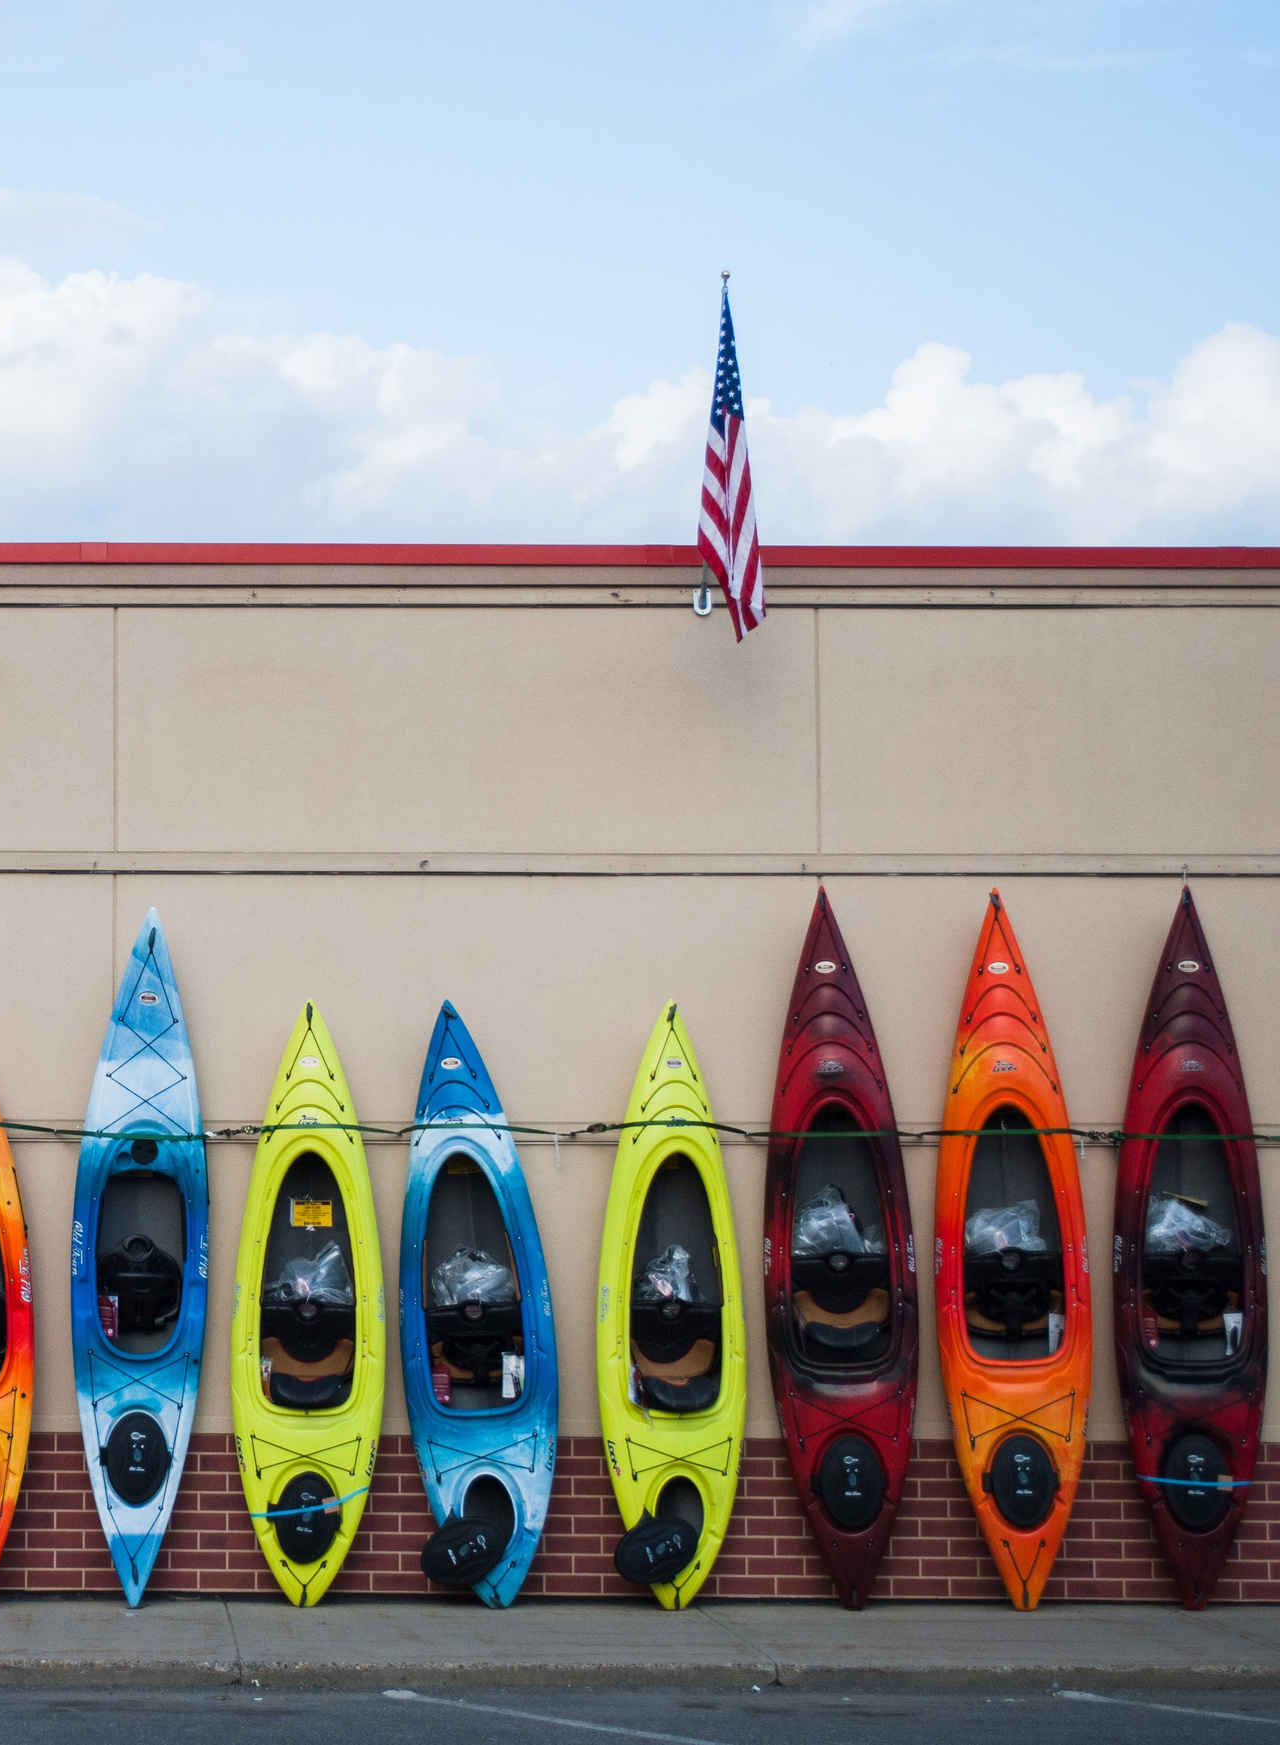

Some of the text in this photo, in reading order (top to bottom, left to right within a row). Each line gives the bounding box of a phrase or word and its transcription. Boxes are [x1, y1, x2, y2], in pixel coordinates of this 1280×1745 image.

[19, 1248, 33, 1303] Old Town
[71, 1220, 84, 1276] Old Town
[198, 1254, 209, 1279] Old
